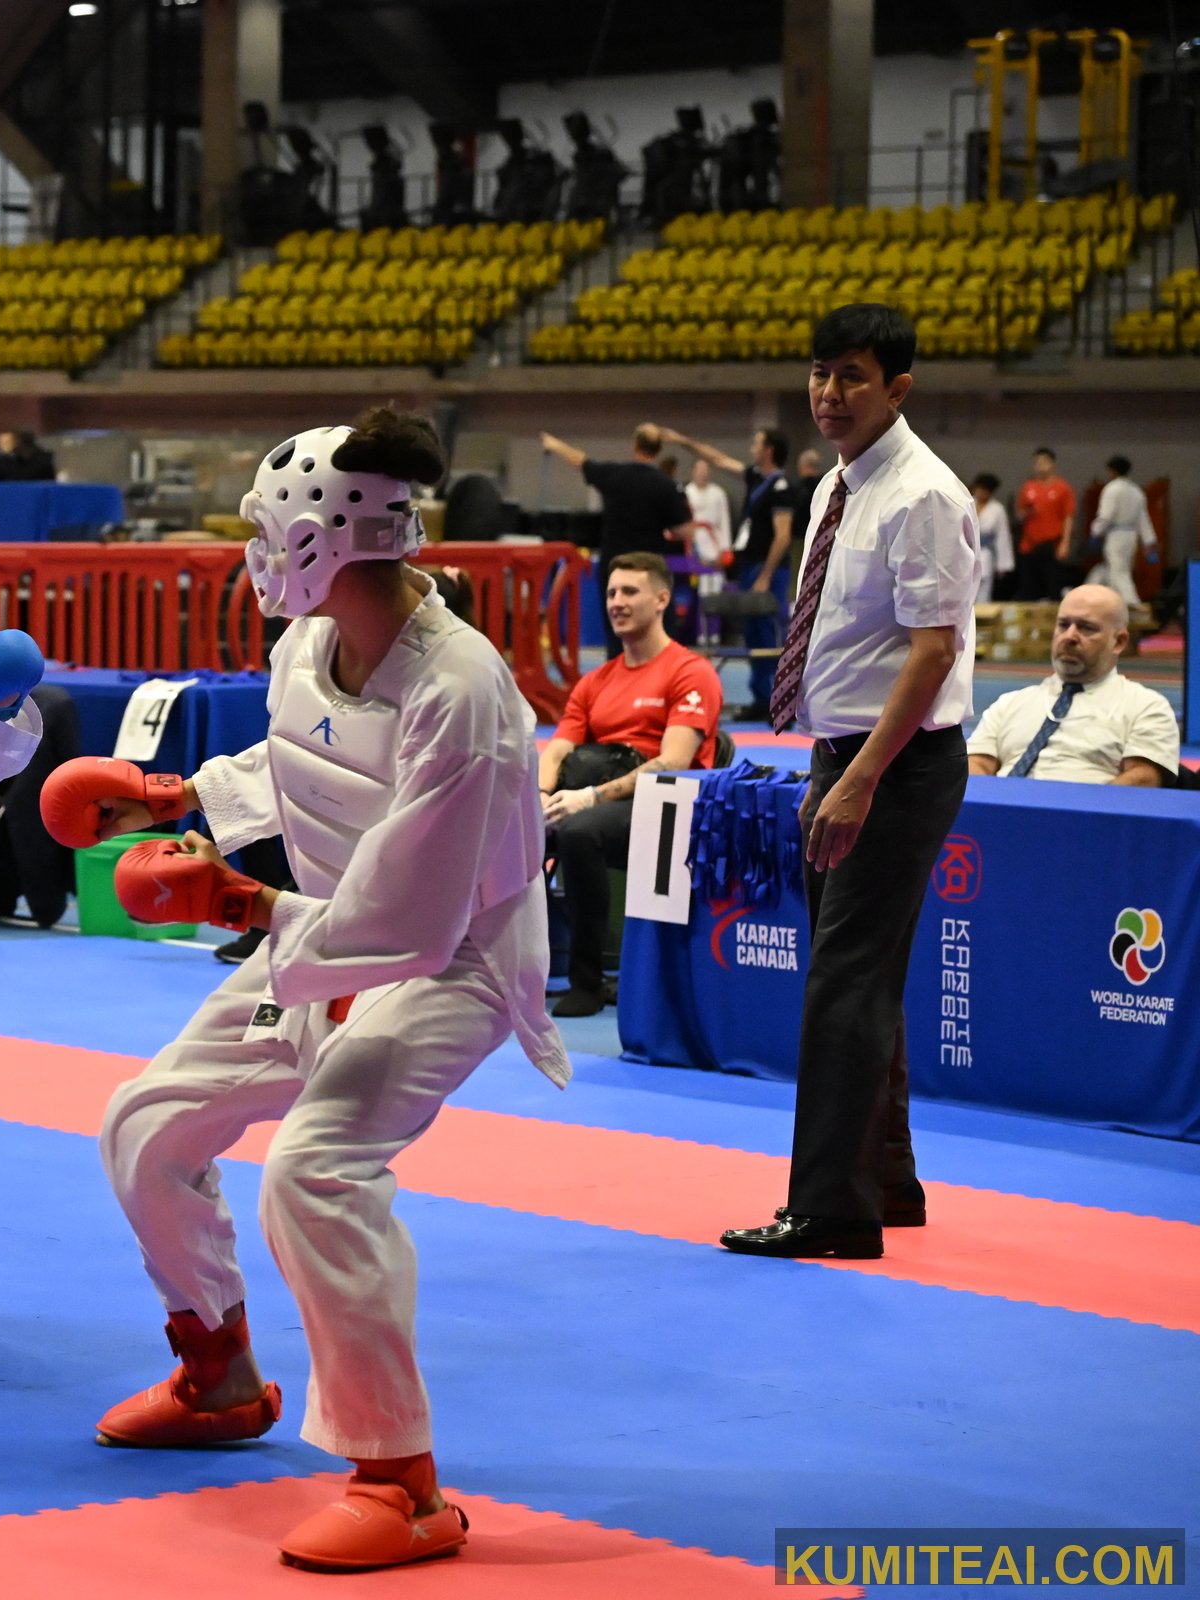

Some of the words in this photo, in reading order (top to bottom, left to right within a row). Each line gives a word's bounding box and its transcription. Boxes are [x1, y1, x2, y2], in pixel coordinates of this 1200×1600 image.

[142, 698, 167, 737] 4
[736, 922, 797, 949] KARATE
[736, 944, 798, 971] CANADA
[1090, 989, 1135, 1007] WORLD
[1135, 994, 1175, 1012] KARATE
[1100, 1005, 1167, 1026] FEDERATION
